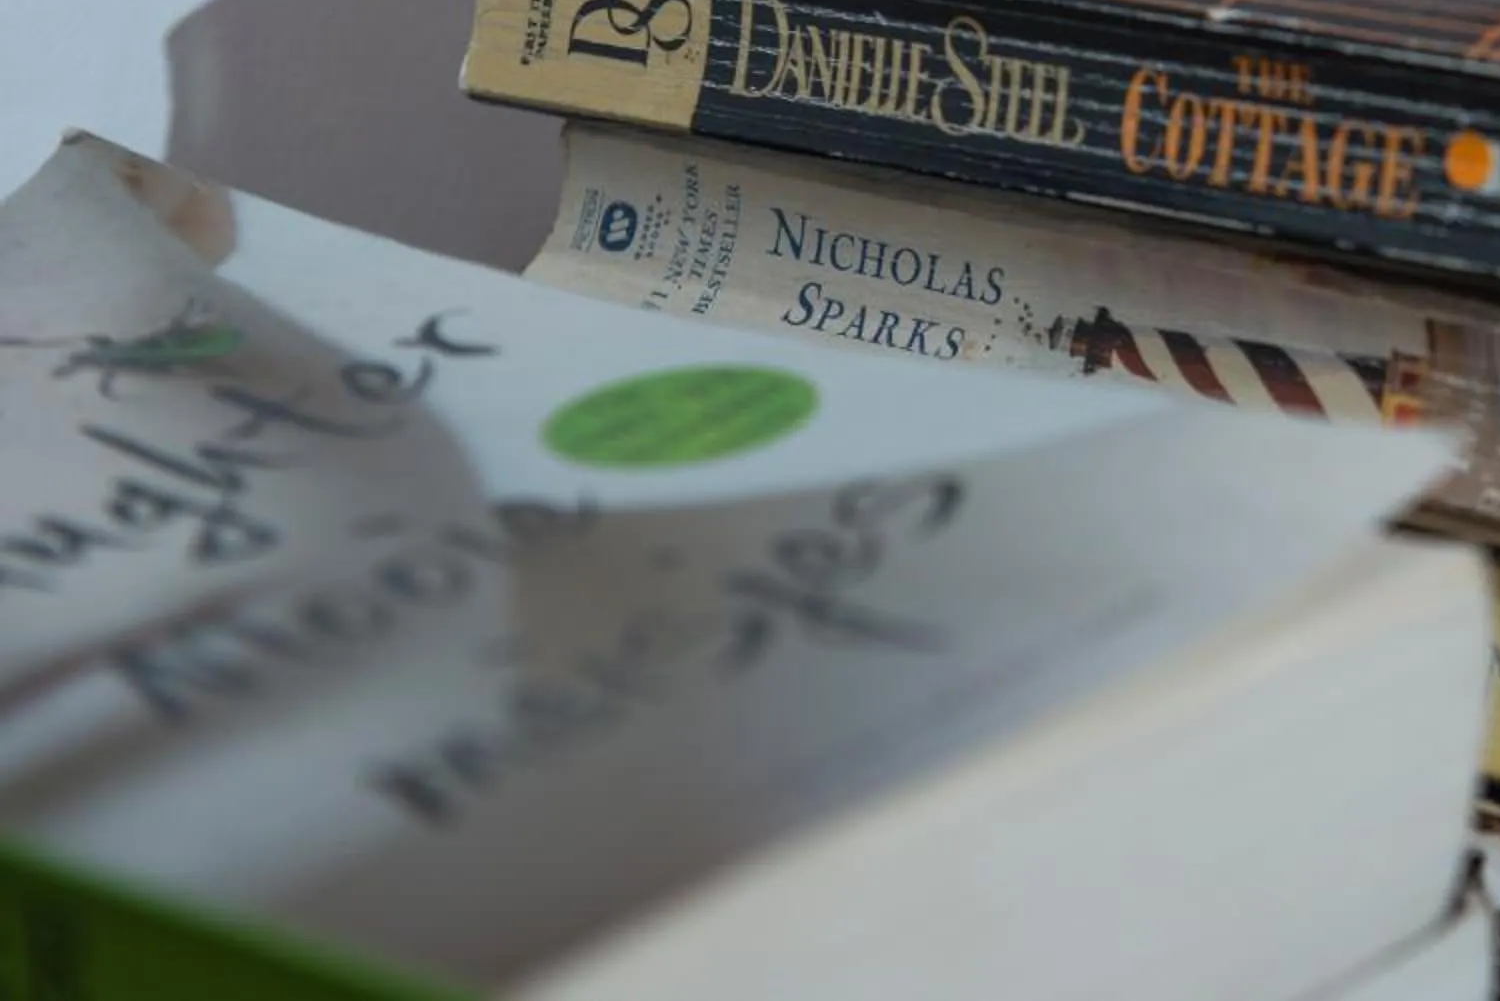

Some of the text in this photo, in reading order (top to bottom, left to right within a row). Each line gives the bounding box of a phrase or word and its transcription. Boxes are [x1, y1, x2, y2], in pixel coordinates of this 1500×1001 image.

[929, 15, 1084, 149] STEEL
[1233, 55, 1314, 106] THE
[1120, 66, 1427, 220] COTTAGE
[663, 226, 690, 281] NEW
[682, 163, 700, 224] YORK
[688, 208, 718, 279] TIMES
[691, 183, 741, 314] BESTSELLER
[766, 207, 1006, 305] NICHOLAS
[781, 282, 966, 361] SPARKS
